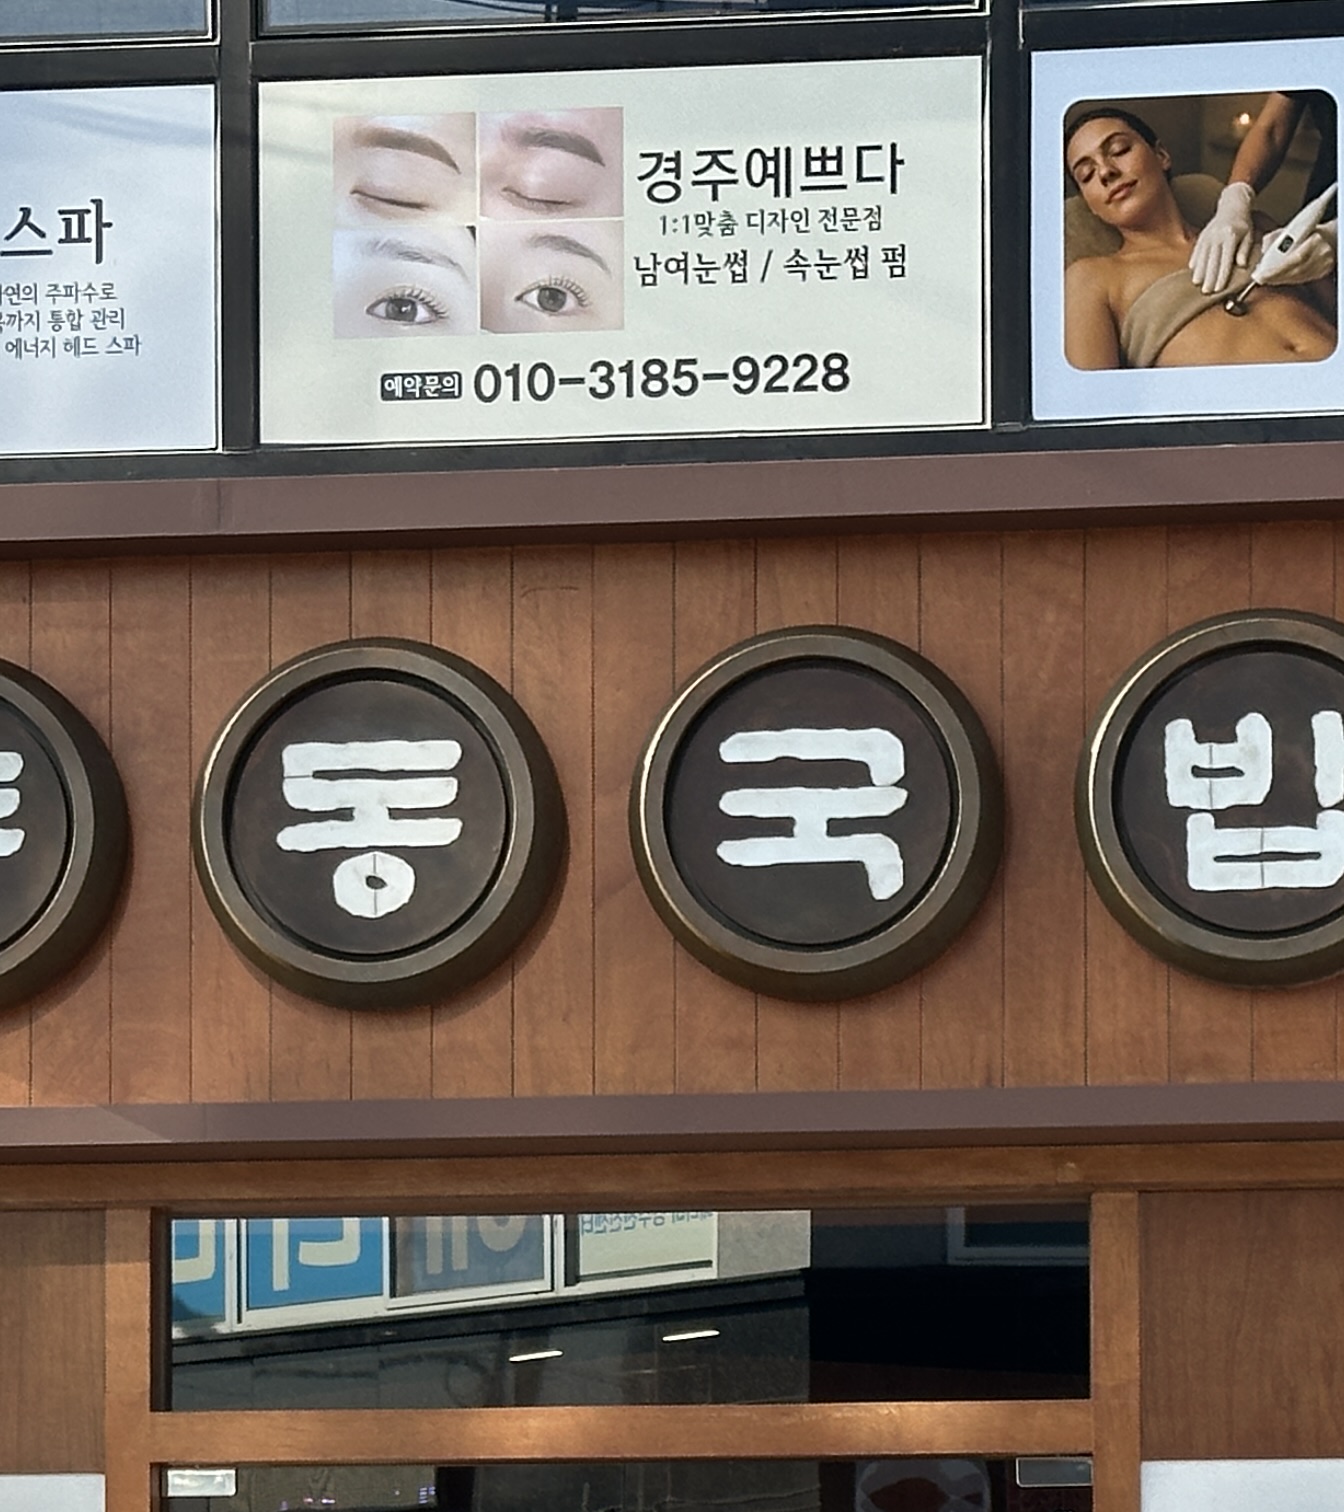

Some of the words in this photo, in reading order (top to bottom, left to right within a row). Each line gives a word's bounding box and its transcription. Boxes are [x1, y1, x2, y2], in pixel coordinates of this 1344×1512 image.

[636, 142, 905, 204] 경주예쁘다
[658, 211, 739, 238] 1:1맞춤
[746, 208, 811, 236] 디자인
[817, 205, 883, 234] 전문점
[633, 250, 749, 289] 남여눈썹
[761, 247, 773, 282] /
[783, 246, 870, 284] 속눈썹
[881, 242, 908, 279] 펌
[46, 280, 118, 306] 주파수로
[47, 308, 84, 333] 통합
[90, 306, 127, 331] 관리
[5, 334, 58, 360] 에너지
[63, 333, 99, 358] 헤드
[105, 331, 143, 357] 스파
[383, 373, 457, 398] 예약문의
[473, 352, 851, 404] 010-3185-9228
